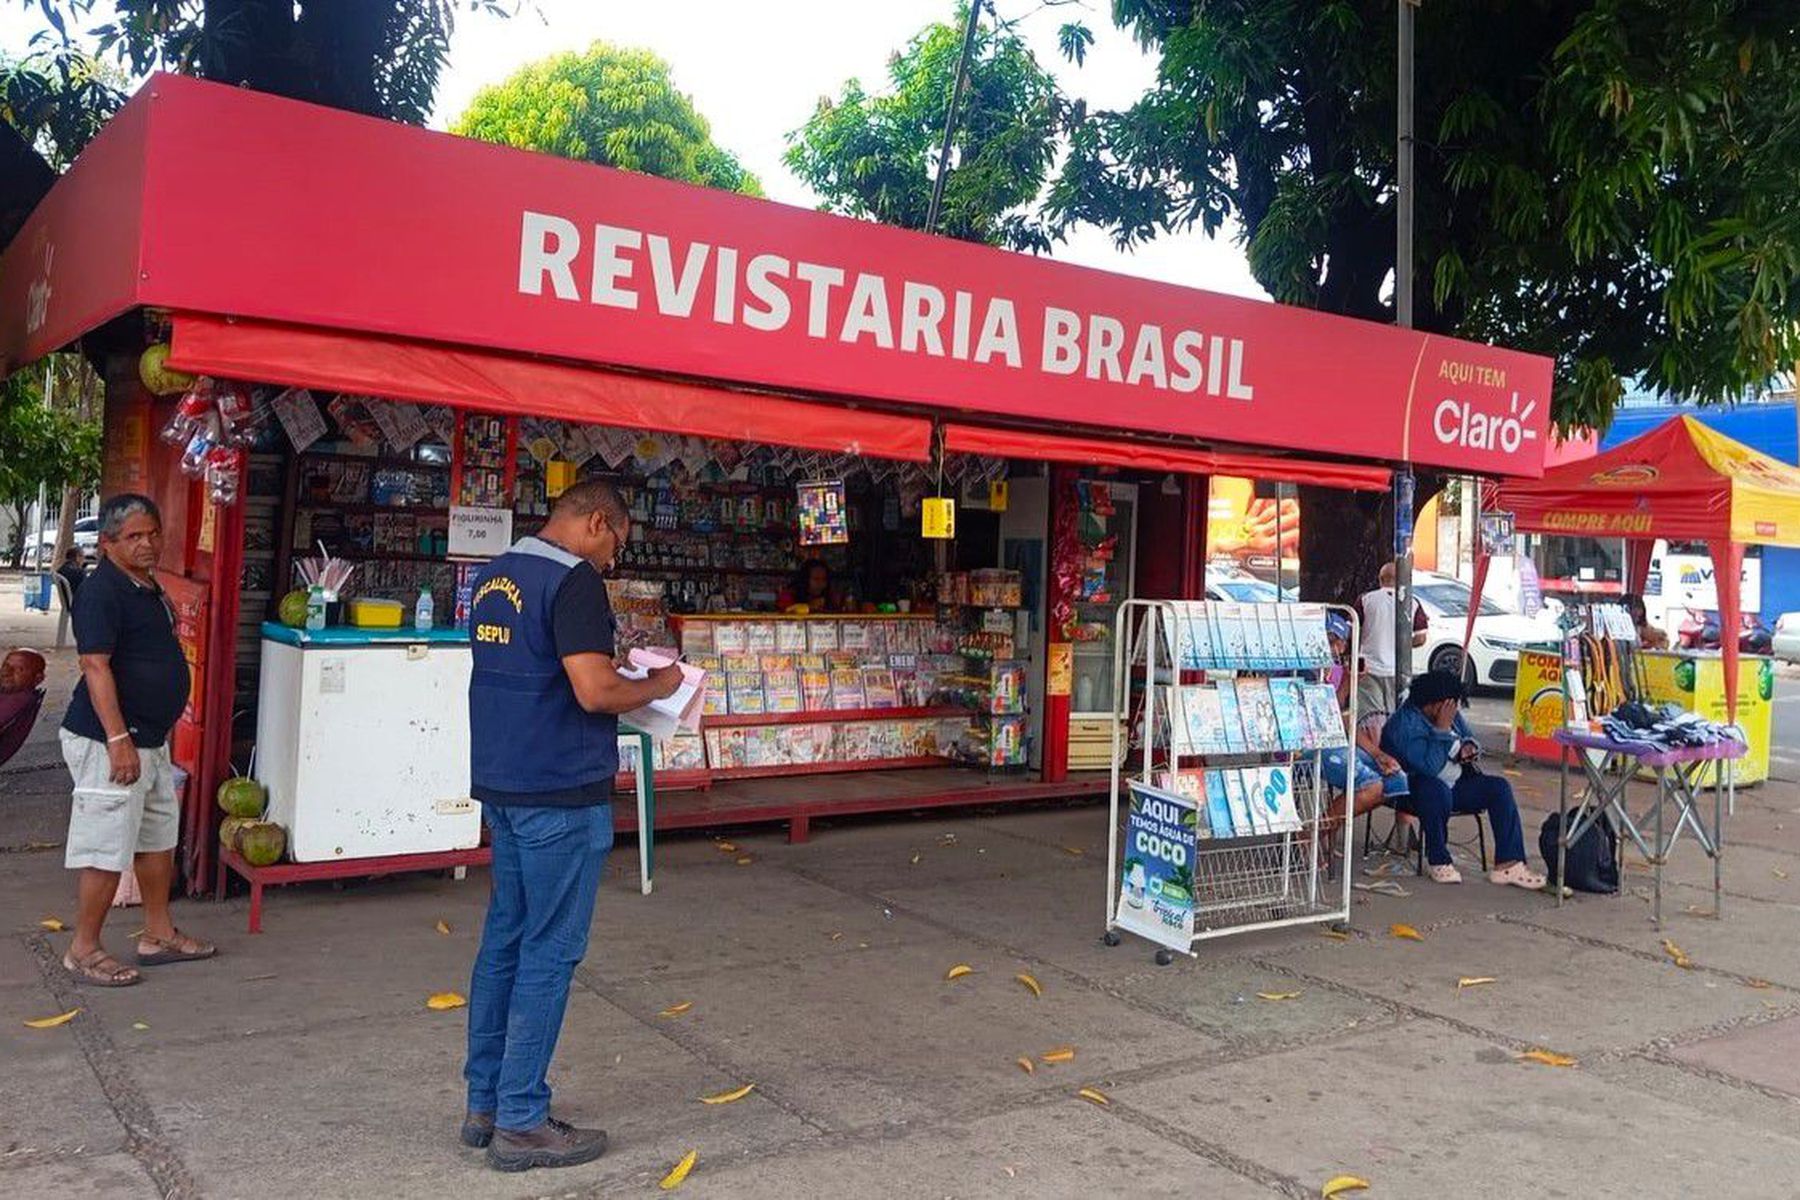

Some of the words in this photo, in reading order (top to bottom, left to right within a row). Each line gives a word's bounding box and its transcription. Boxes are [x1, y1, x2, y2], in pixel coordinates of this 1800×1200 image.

[518, 210, 1023, 369] REVISTARIA
[1041, 306, 1254, 401] BRASIL
[1439, 360, 1474, 385] AQUI
[1475, 366, 1507, 388] TEM
[1433, 396, 1525, 454] Claro
[452, 513, 503, 524] FIGURINHA
[1543, 511, 1605, 531] COMPRE
[1609, 515, 1653, 533] AQUI
[1141, 798, 1180, 826] AQUI
[1130, 814, 1159, 834] TEMOS
[1183, 833, 1195, 846] DE
[1136, 831, 1187, 866] COCO
